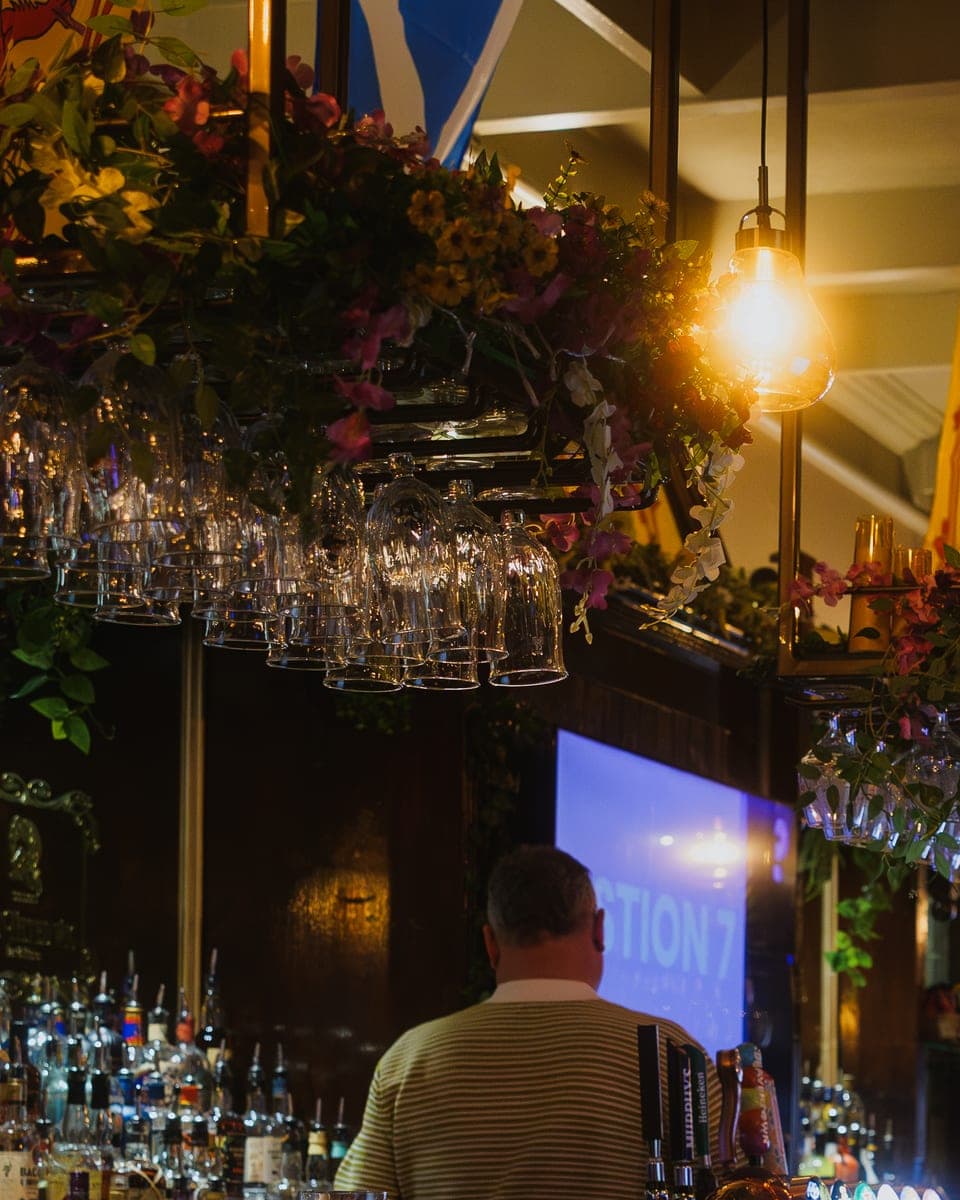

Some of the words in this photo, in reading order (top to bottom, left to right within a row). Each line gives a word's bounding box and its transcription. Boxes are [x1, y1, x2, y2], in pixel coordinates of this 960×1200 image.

[596, 877, 709, 976] STION
[717, 908, 737, 980] 7
[697, 1072, 707, 1123] Heineken
